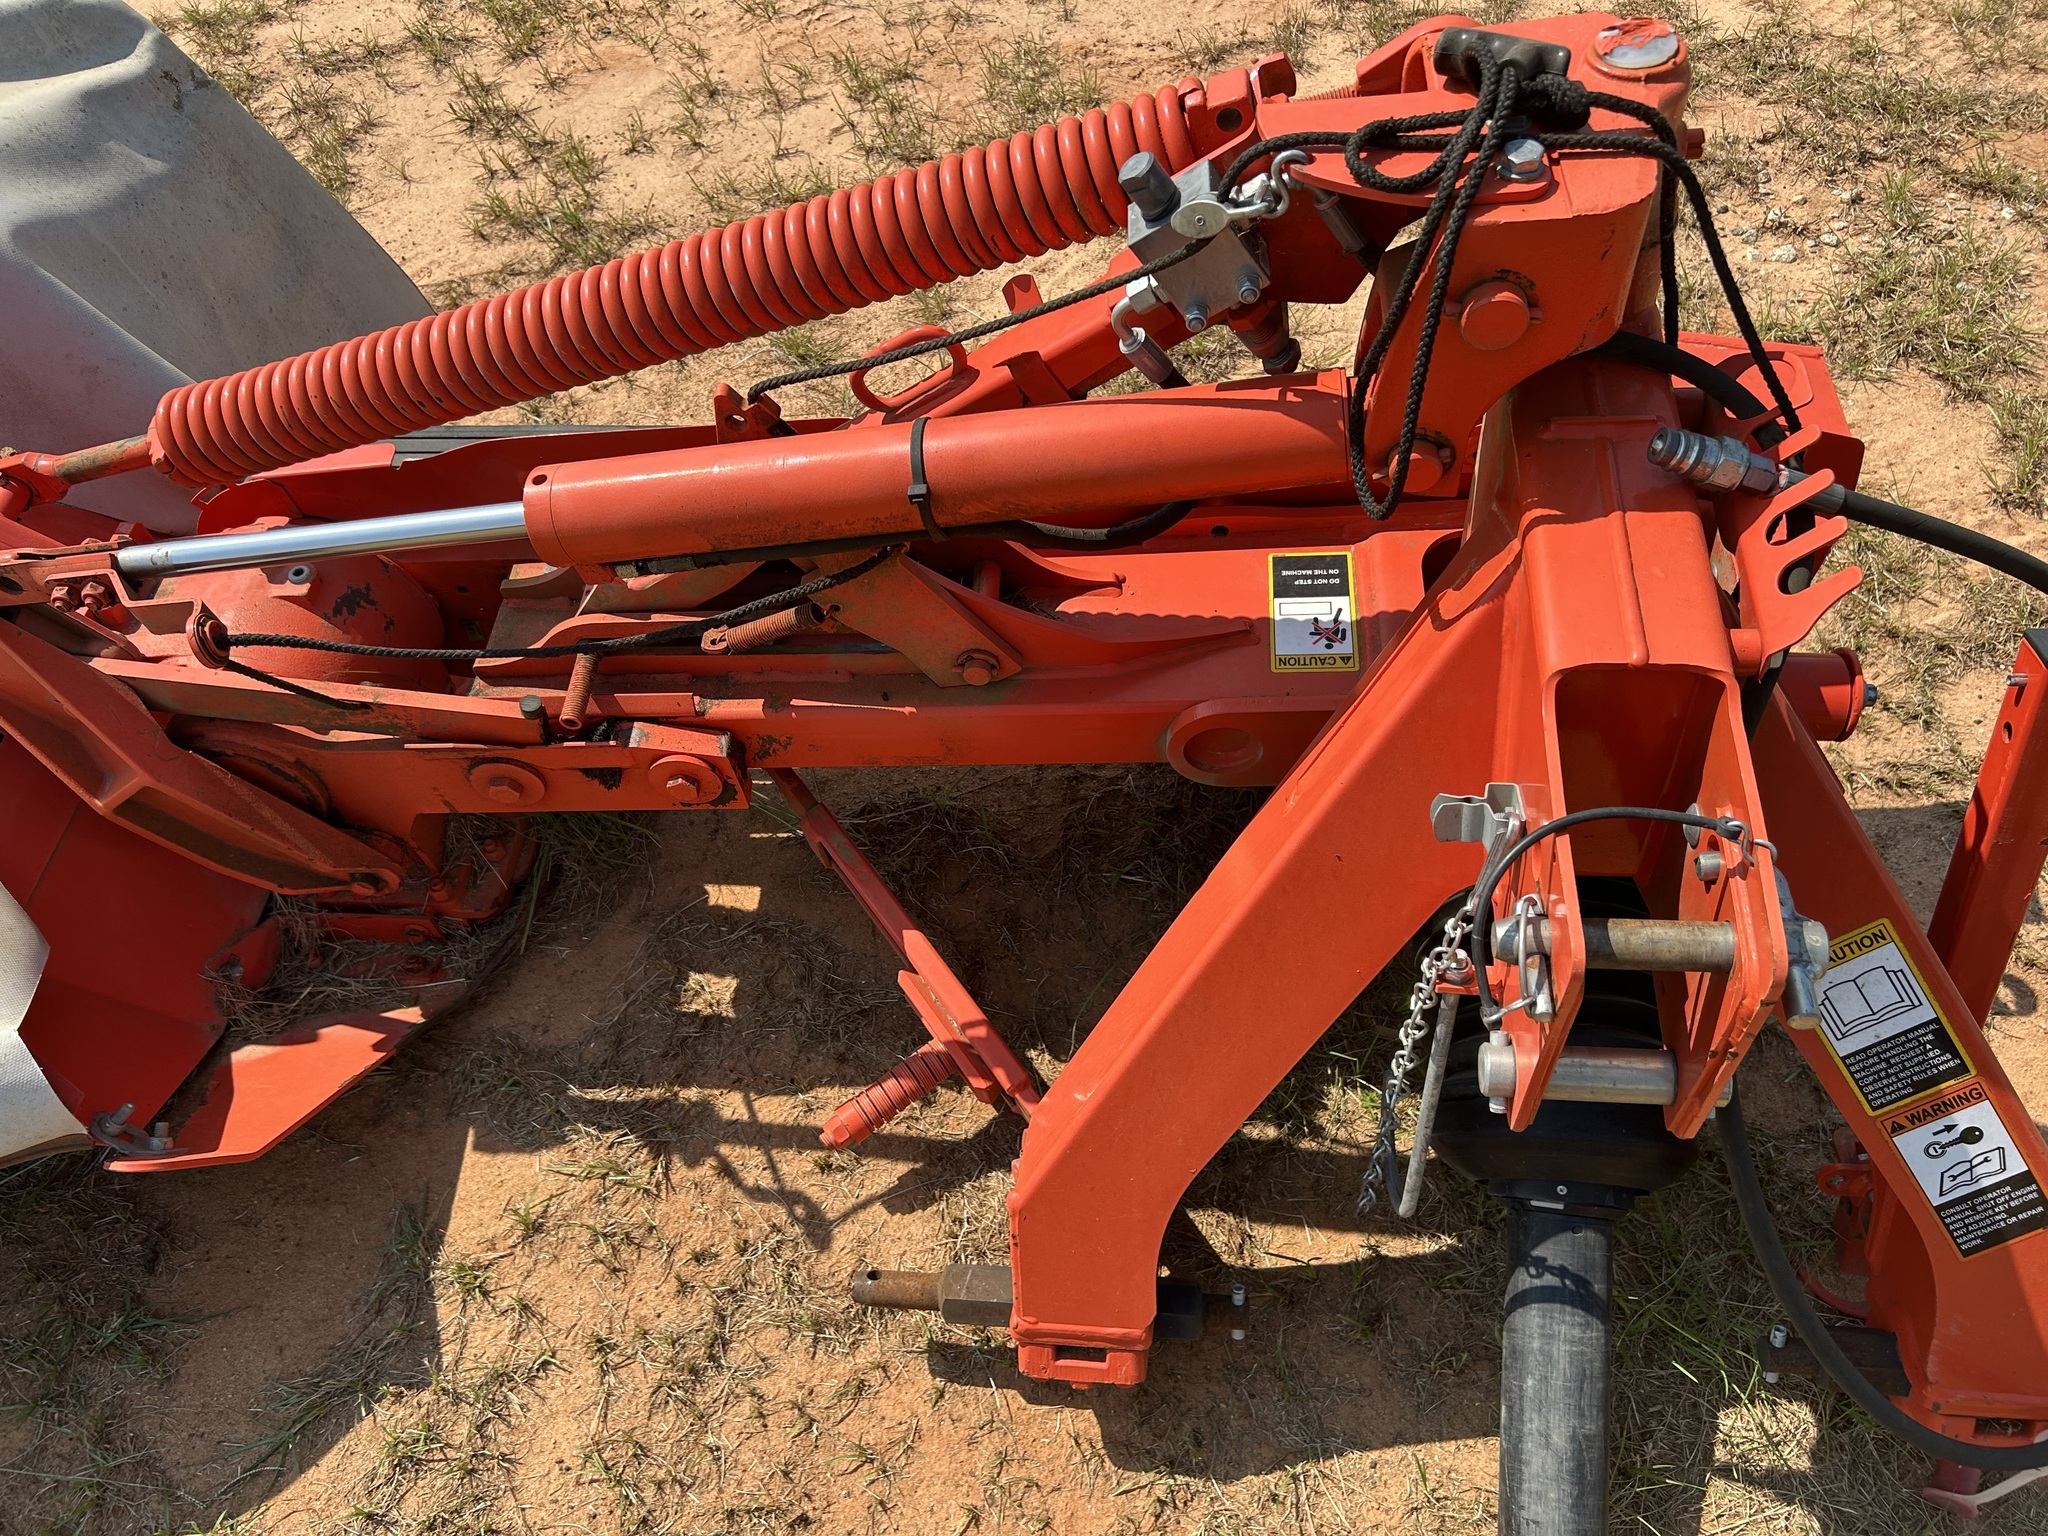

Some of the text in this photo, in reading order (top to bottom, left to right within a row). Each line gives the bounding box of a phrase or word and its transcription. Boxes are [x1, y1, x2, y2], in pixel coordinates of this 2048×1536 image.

[1278, 656, 1335, 666] CAUTION
[1825, 928, 1886, 964] UTION
[1845, 1021, 1939, 1064] READ OPERATOR MANUAL
[1850, 1033, 1934, 1072] BEFORE HANDLING THE
[1890, 1046, 1924, 1064] REQUEST
[1858, 1074, 1879, 1086] COPY
[1887, 1064, 1903, 1074] NOT
[1862, 1052, 1951, 1093] OBSERVE INSTRUCTIONS
[1867, 1090, 1883, 1100] AND
[1883, 1078, 1911, 1093] SAFETY
[1912, 1067, 1937, 1081] RULES
[1937, 1058, 1961, 1071] WHEN
[1904, 1085, 1983, 1127] WARNING
[1940, 1185, 2011, 1217] CONSULT OPERATOR
[1948, 1191, 2039, 1230] AND REMOVE KEY BEFORE
[1976, 1200, 1995, 1211] SHUT
[1995, 1194, 2010, 1203] OFF
[2010, 1183, 2037, 1198] ENGINE
[1952, 1227, 1967, 1237] ANY
[1956, 1205, 2044, 1243] MAINTENANCE OR REPAIR
